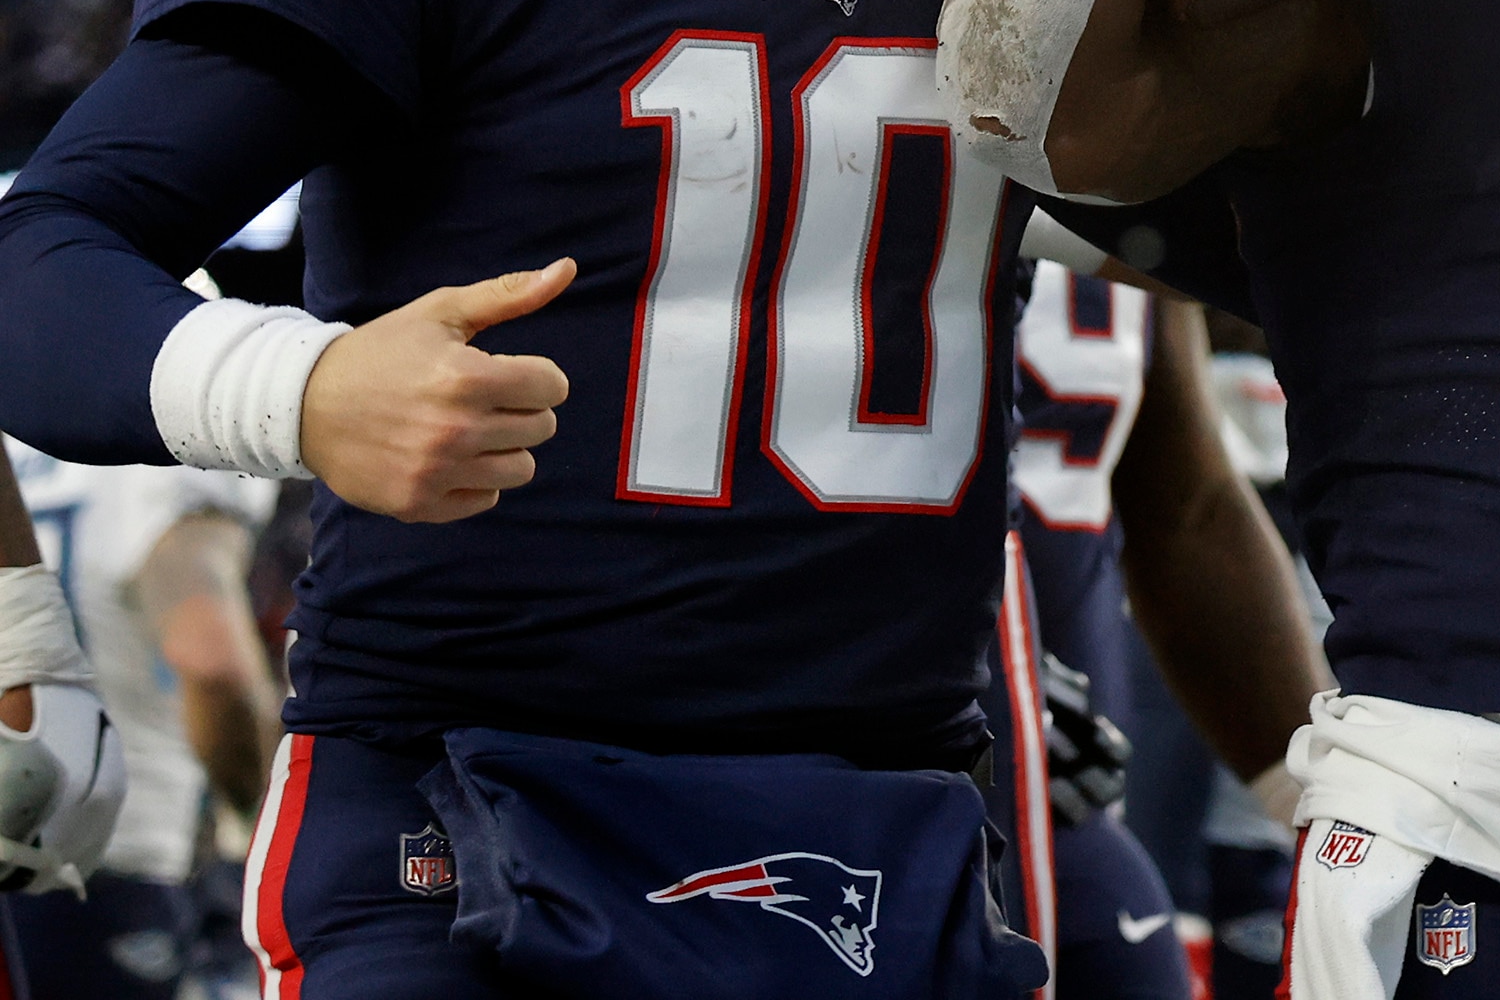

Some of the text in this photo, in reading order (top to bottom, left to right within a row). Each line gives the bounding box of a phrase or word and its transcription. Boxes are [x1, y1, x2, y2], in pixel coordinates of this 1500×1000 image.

[615, 28, 1010, 517] 10
[1321, 833, 1365, 865] NFL
[409, 857, 452, 886] NFL
[1426, 930, 1466, 959] NFL
